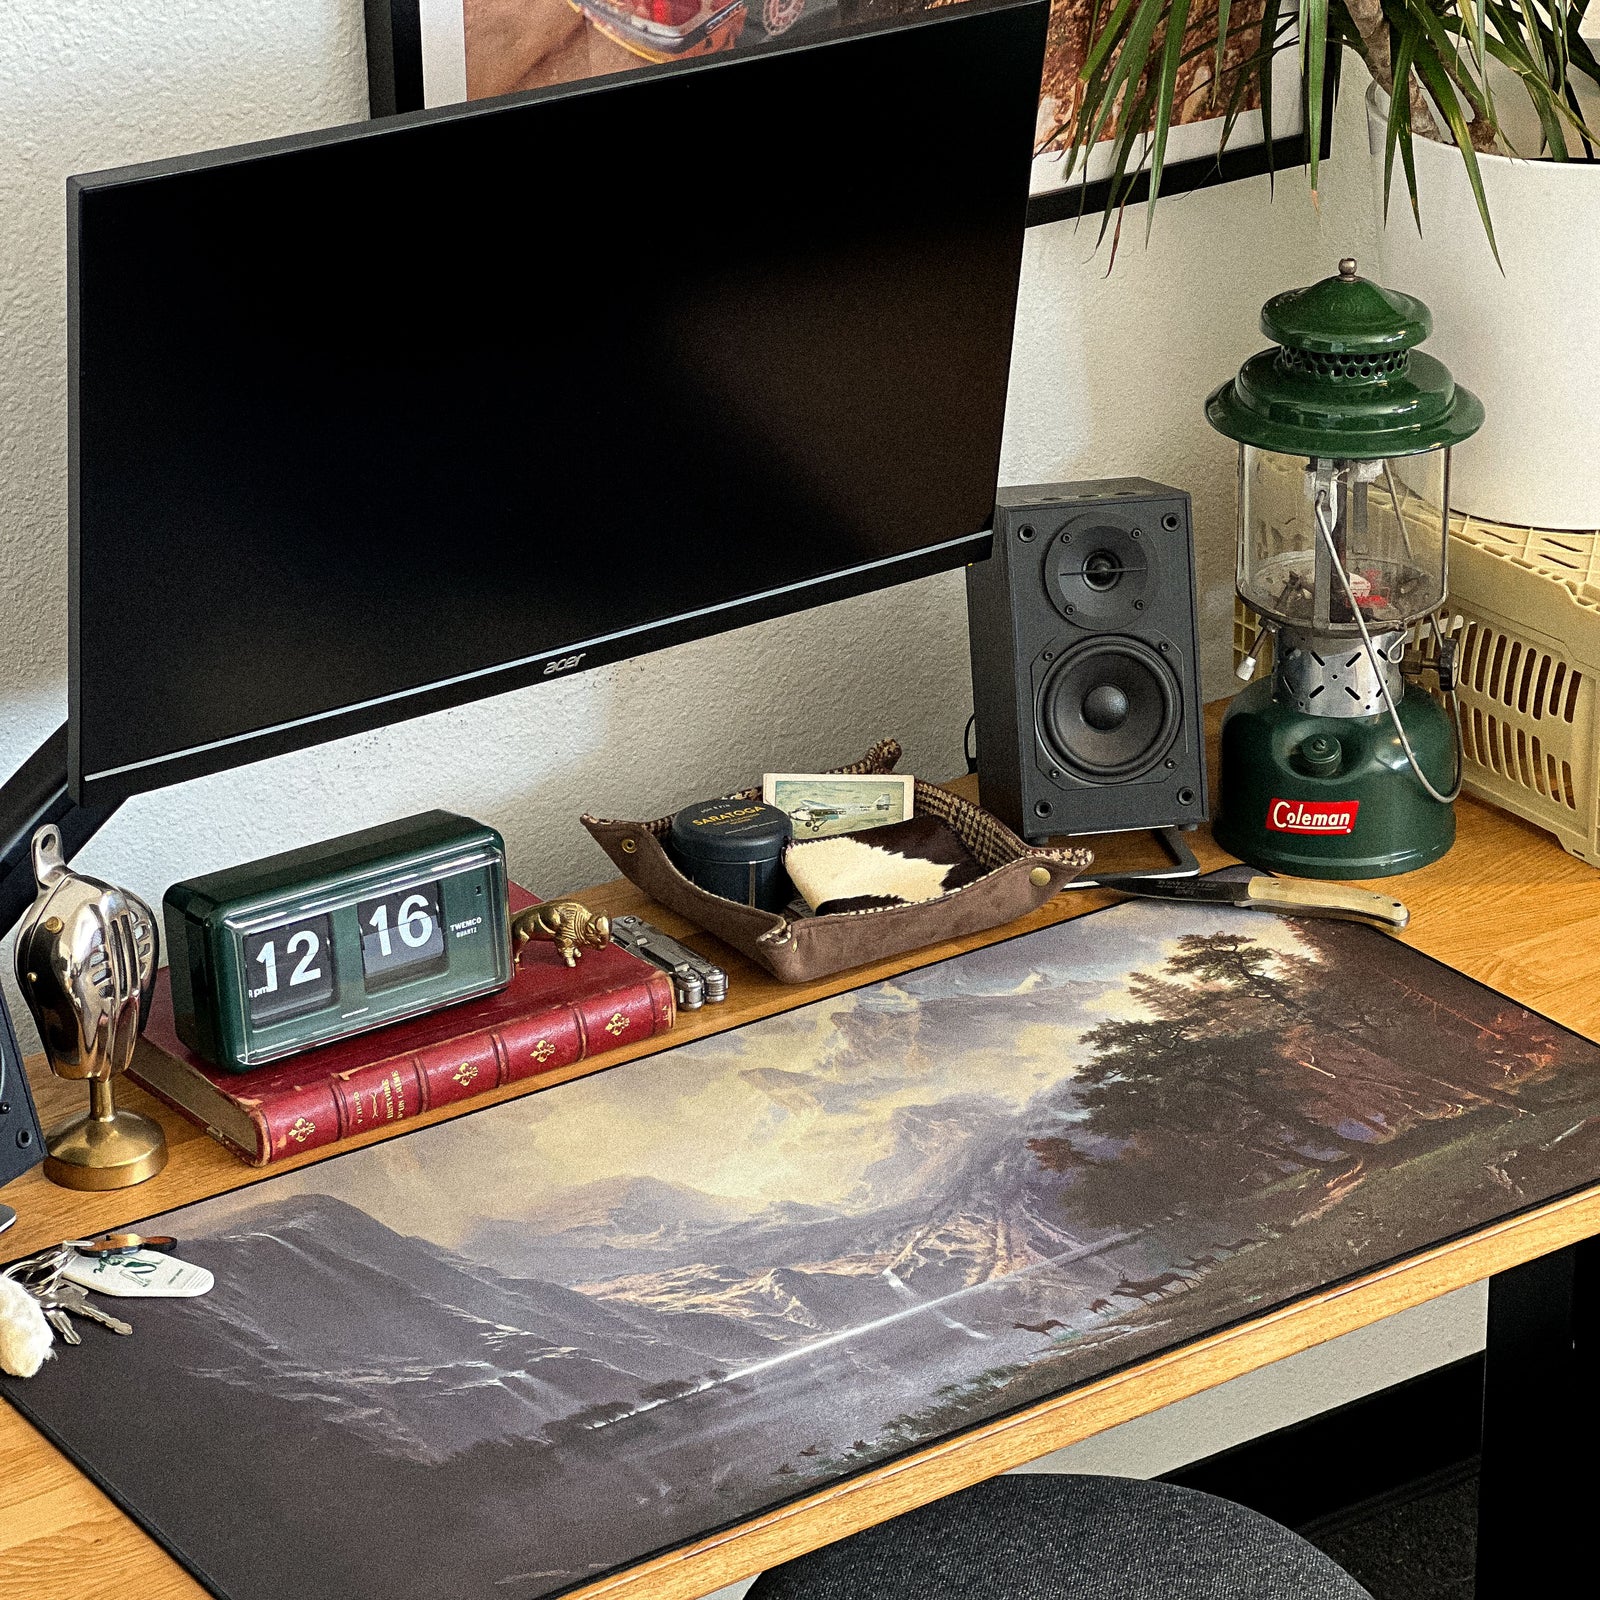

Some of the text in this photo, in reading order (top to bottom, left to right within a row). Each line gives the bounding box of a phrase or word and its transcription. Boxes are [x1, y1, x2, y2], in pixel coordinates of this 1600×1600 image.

[543, 653, 587, 675] acer
[692, 806, 766, 826] SARATOGA
[1273, 801, 1351, 829] Coleman
[450, 916, 482, 932] TWEMCO
[256, 894, 433, 991] 12 16
